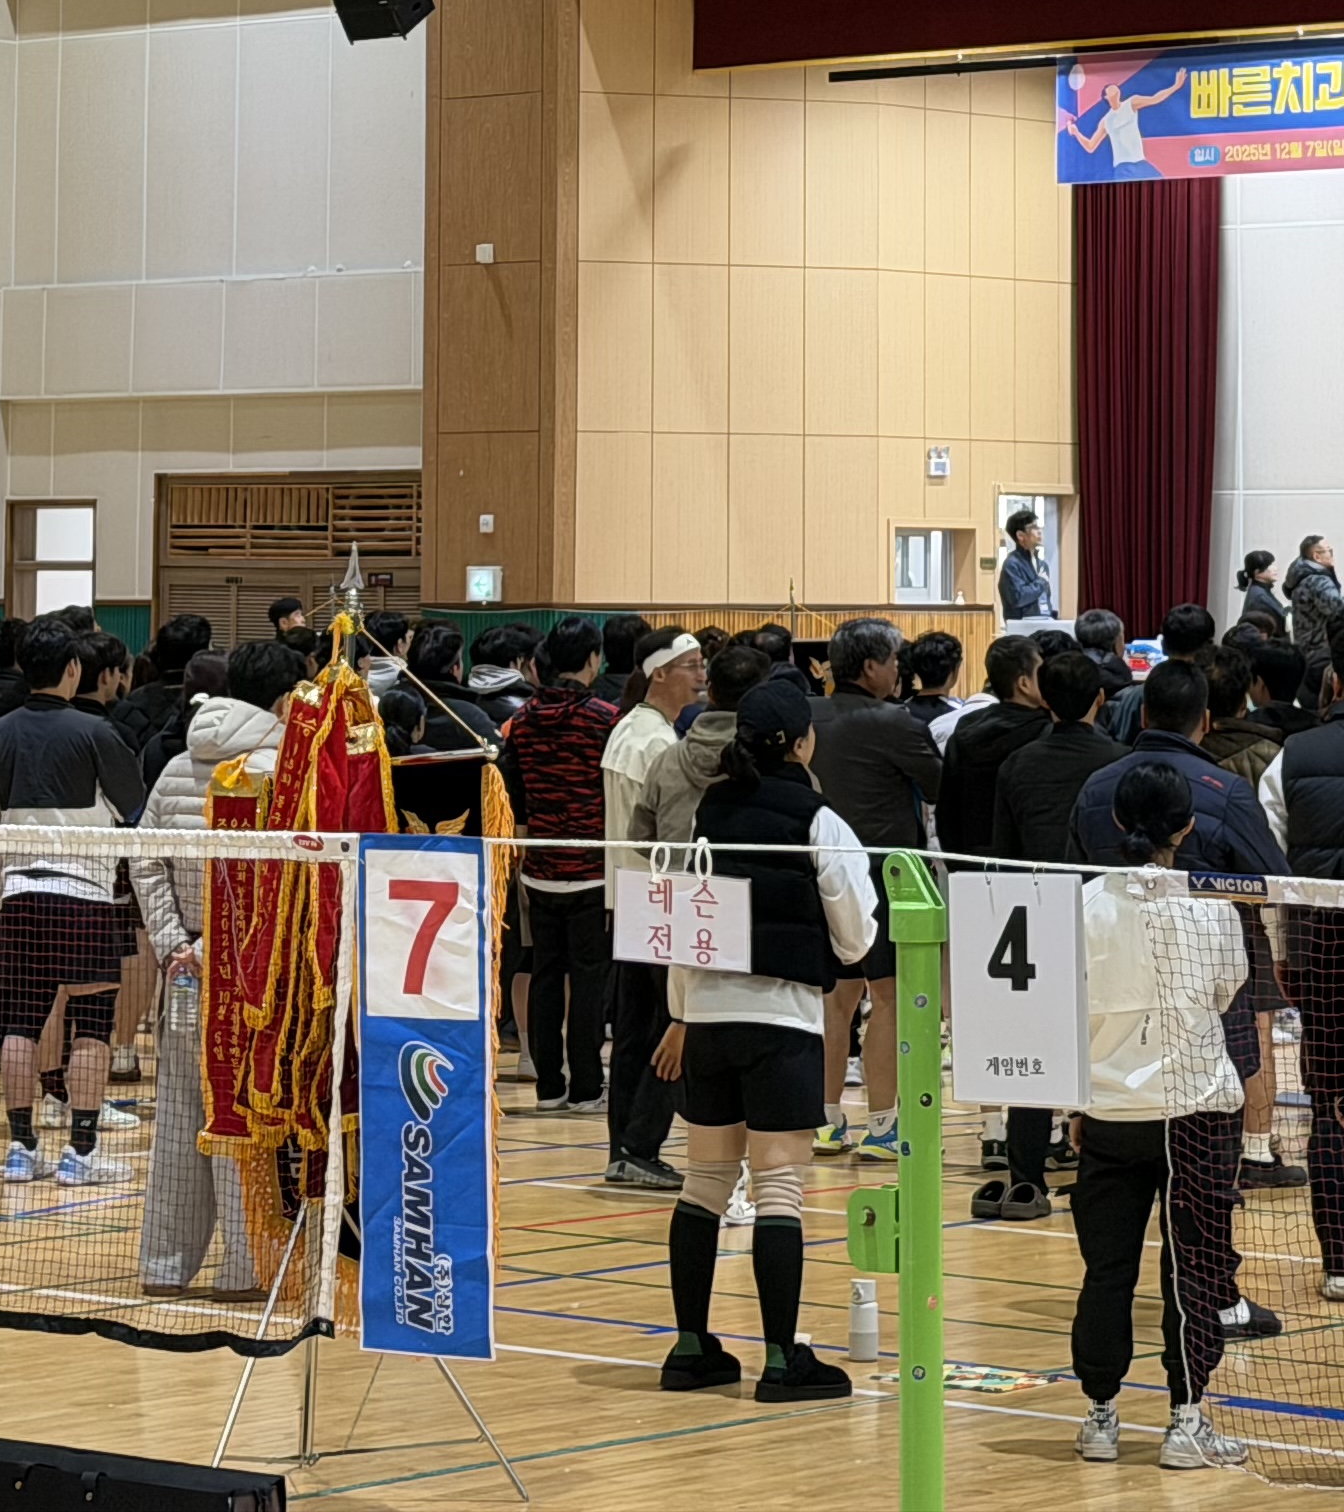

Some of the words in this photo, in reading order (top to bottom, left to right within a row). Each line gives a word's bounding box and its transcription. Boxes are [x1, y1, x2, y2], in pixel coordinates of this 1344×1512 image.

[1193, 149, 1215, 163] 일시
[1224, 145, 1272, 162] 2025년
[1274, 142, 1303, 160] 12월
[647, 878, 719, 919] 레슨
[1209, 877, 1265, 894] VICTOR
[388, 878, 460, 995] 7
[647, 923, 719, 965] 전용
[987, 905, 1037, 992] 4
[985, 1056, 1045, 1077] 게임번호
[393, 1216, 402, 1274] SAMHAN
[401, 1120, 436, 1334] SAMHAN
